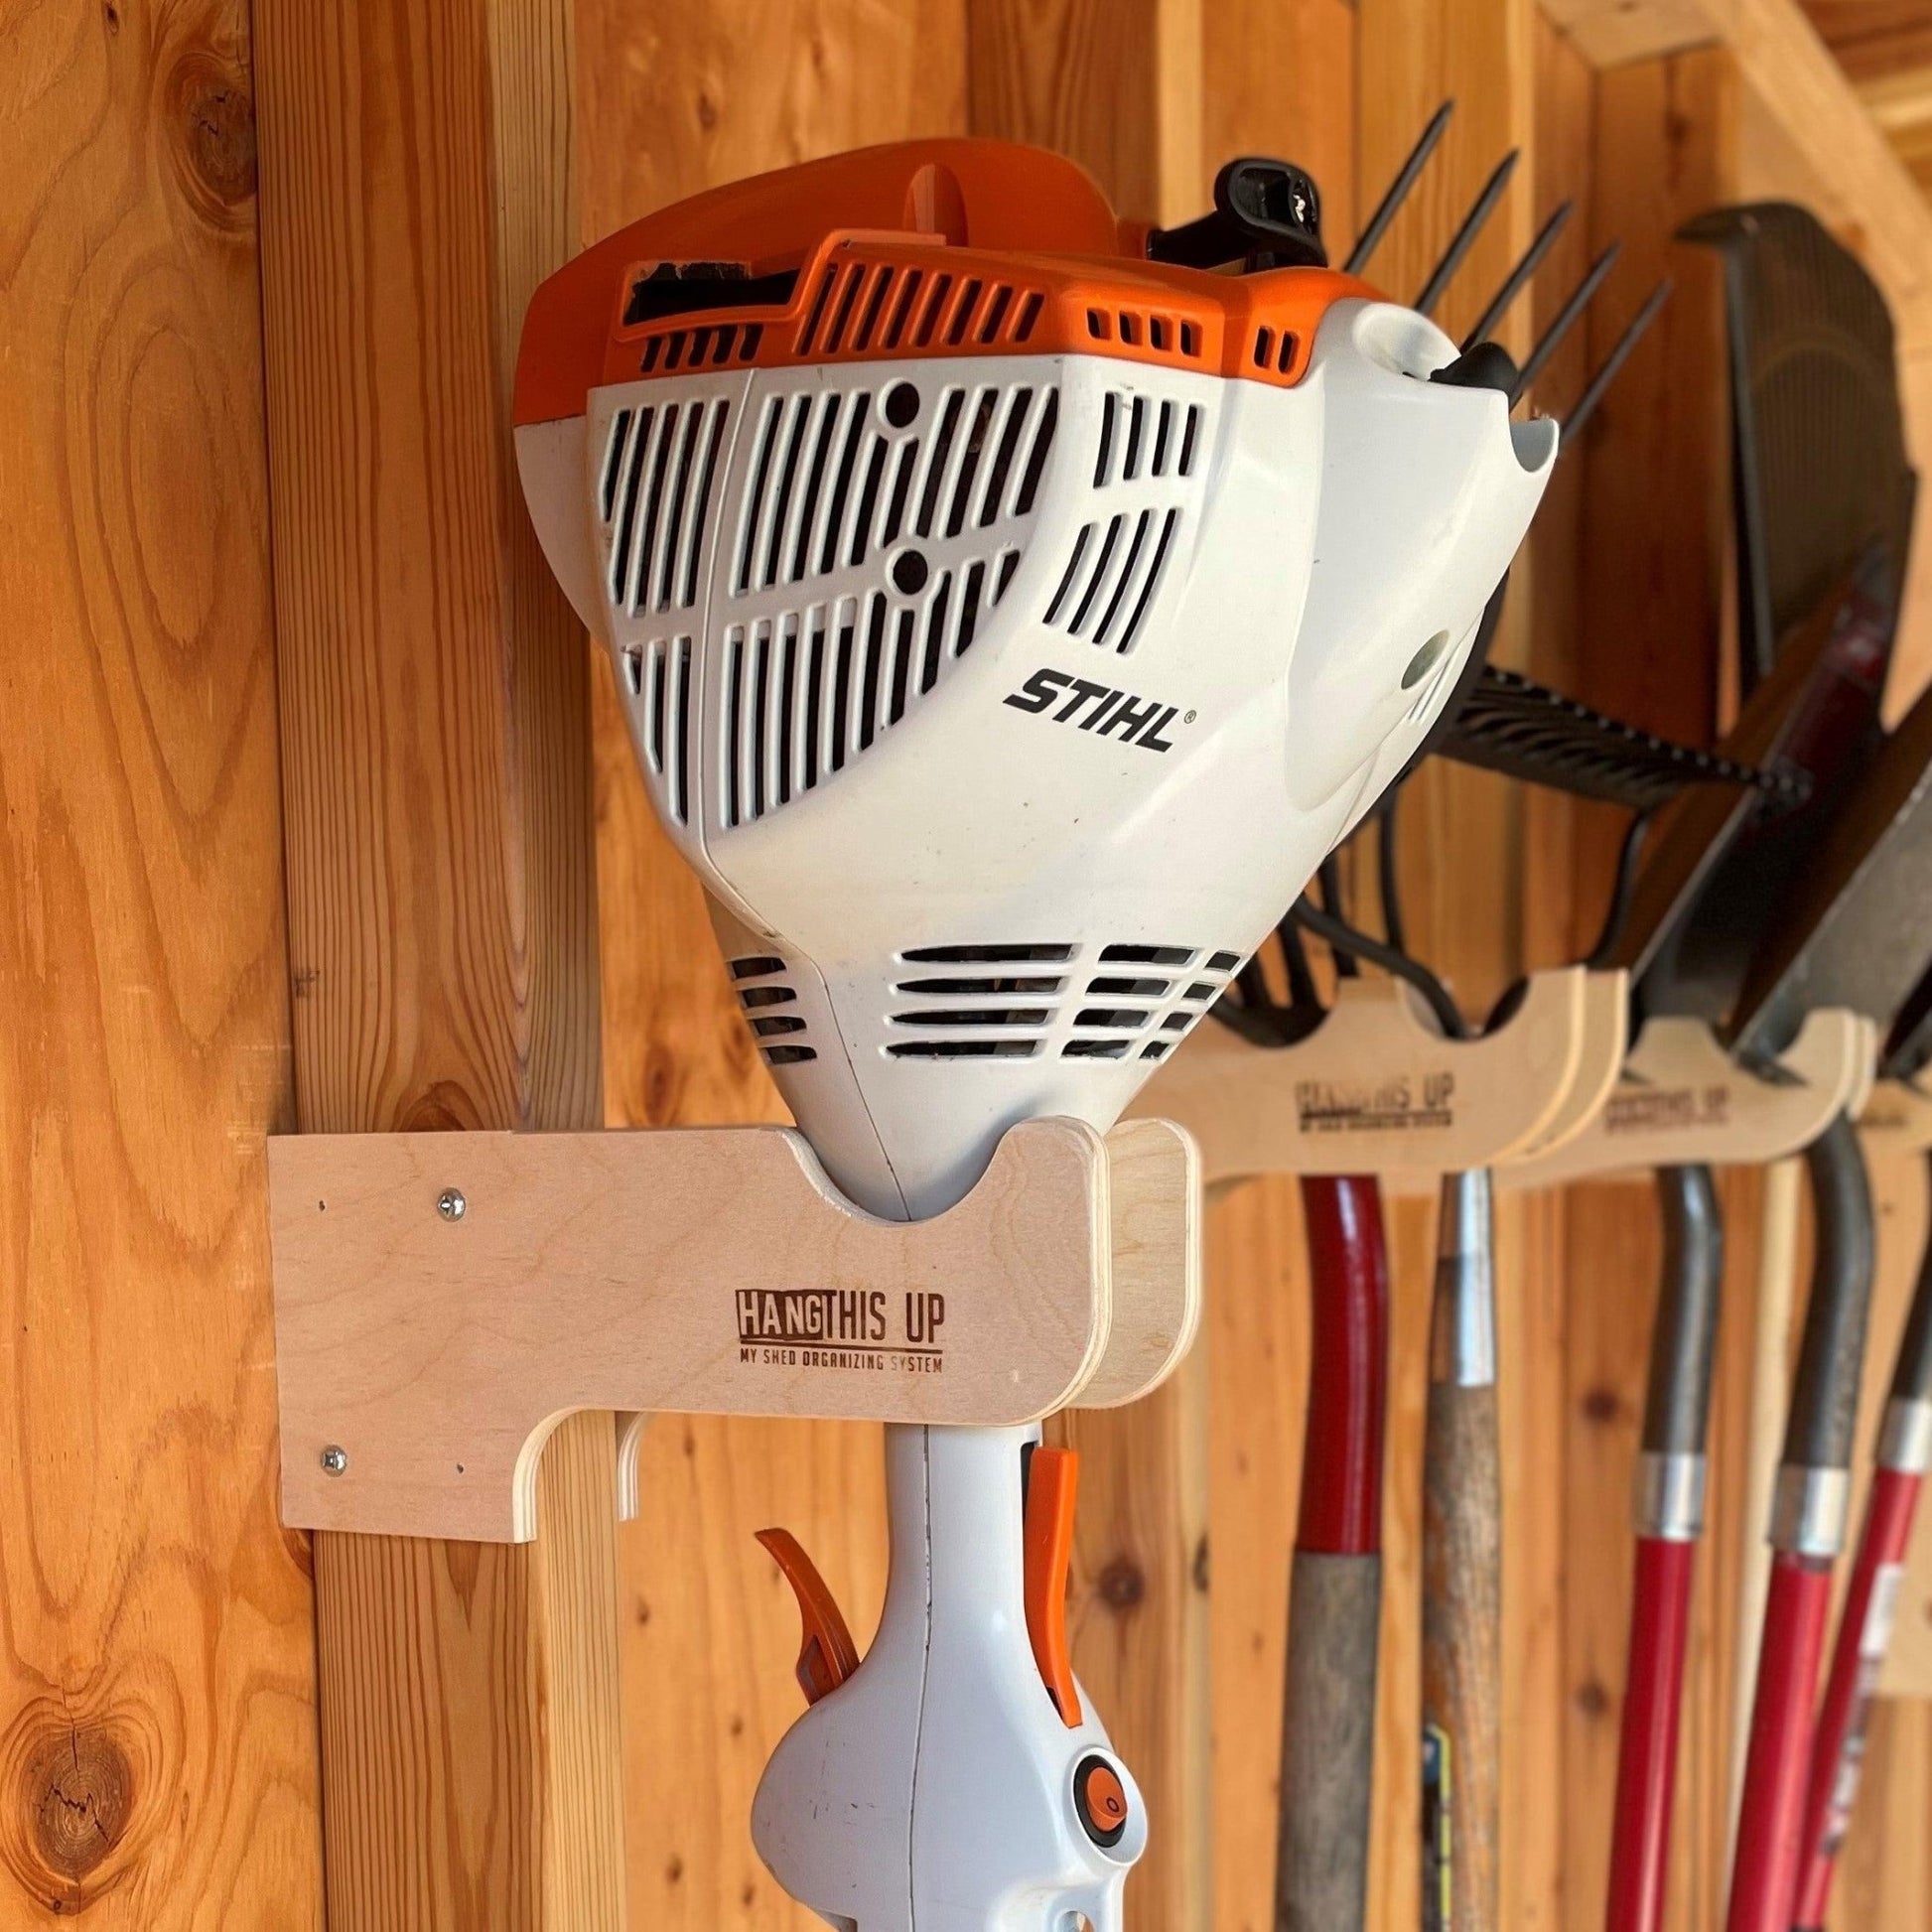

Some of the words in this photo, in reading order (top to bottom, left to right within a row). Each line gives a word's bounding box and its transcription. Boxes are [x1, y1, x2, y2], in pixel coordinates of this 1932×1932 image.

[1003, 668, 1179, 753] STIHL
[905, 1292, 945, 1344] UP
[740, 1348, 758, 1364] MY
[763, 1348, 796, 1366] SHED
[802, 1350, 884, 1371] ORGANIZING
[890, 1355, 943, 1374] SYSTEM
